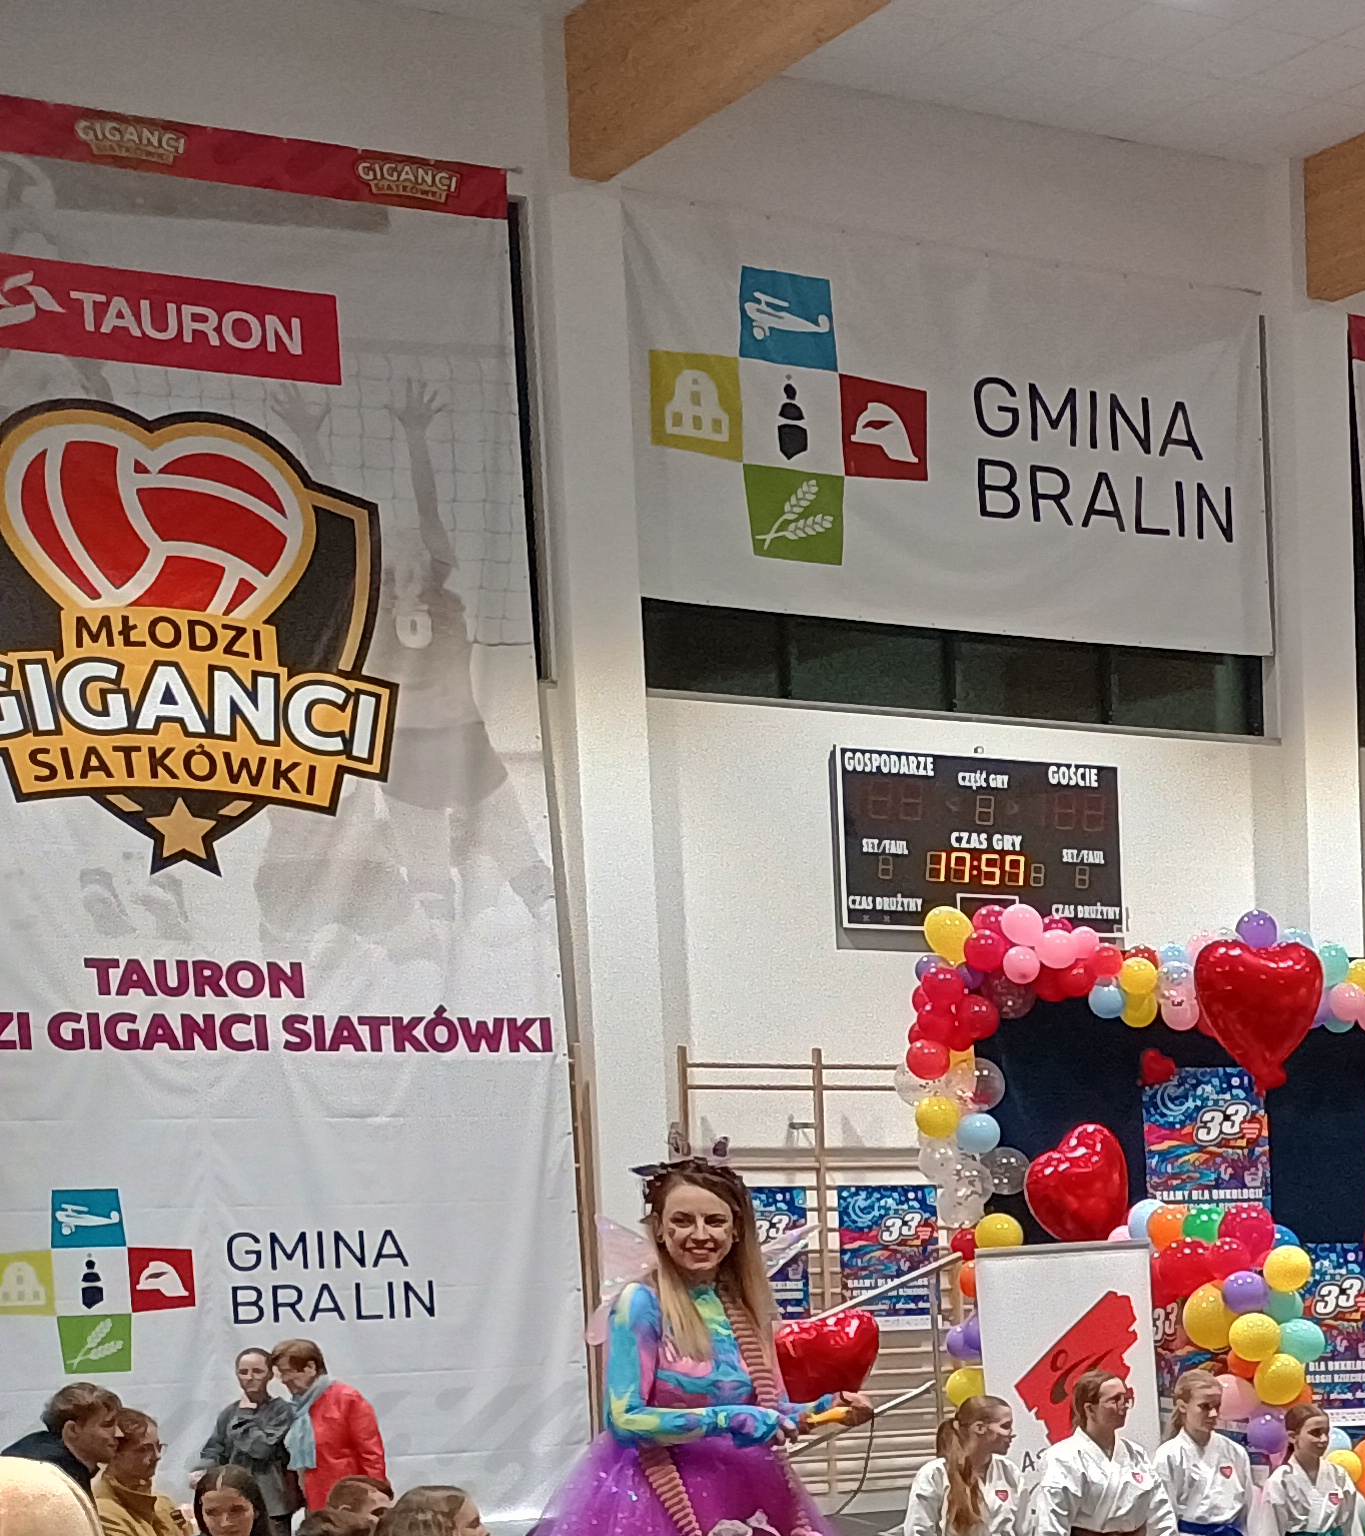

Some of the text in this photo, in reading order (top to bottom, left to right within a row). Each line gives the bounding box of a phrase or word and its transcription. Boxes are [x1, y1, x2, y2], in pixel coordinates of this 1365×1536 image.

[75, 119, 186, 154] GIGANCI
[357, 162, 458, 192] GIGANCI
[69, 289, 303, 355] TAURON
[972, 375, 1203, 461] GMINA
[976, 457, 1235, 544] BRALIN
[74, 613, 263, 661] MŁODZI
[28, 743, 317, 797] SIATKÓWKI
[844, 751, 935, 776] GOSPODARZE
[989, 774, 1009, 789] GRY
[1048, 763, 1099, 787] GOŚCIE
[951, 831, 1023, 851] CZAS GRY
[849, 895, 874, 910] CZAS
[1051, 903, 1075, 919] CZAS
[84, 957, 306, 999] TAURON
[47, 1011, 269, 1051] GIGANCI
[282, 1004, 553, 1054] SIATKÓWKI
[1196, 1103, 1248, 1142] 33
[880, 1211, 923, 1244] 33
[226, 1228, 410, 1272] GMINA
[231, 1279, 437, 1325] BRALIN
[1315, 1277, 1364, 1315] 33
